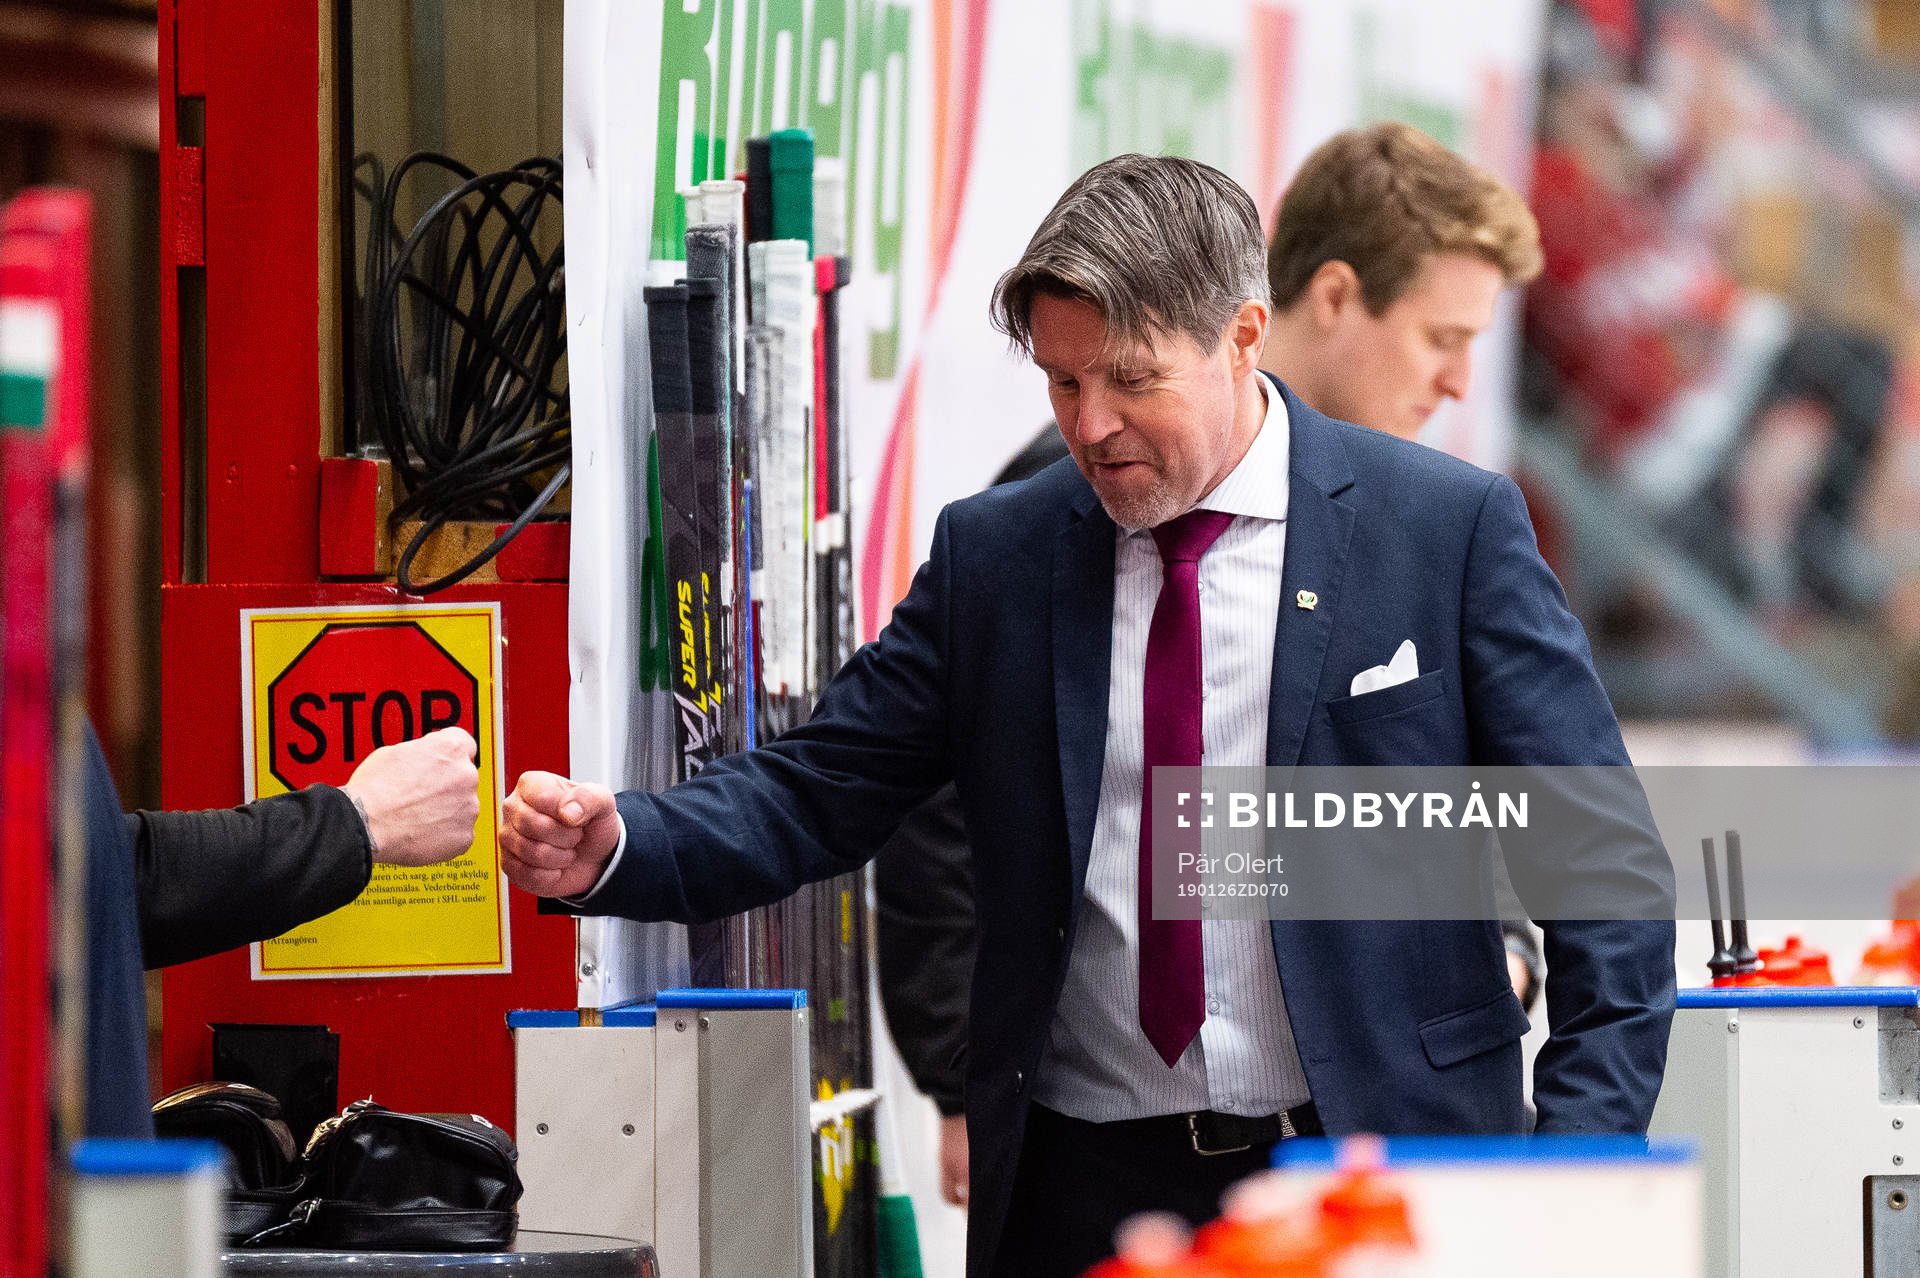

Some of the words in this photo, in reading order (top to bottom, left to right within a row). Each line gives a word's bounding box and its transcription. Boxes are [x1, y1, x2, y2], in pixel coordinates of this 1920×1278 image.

[677, 579, 698, 690] SUPER
[286, 689, 463, 765] STOP
[393, 872, 408, 881] och
[431, 872, 444, 882] gör
[447, 871, 458, 882] sig
[460, 869, 489, 881] skyldig
[366, 883, 420, 896] polisanmälas.
[423, 881, 481, 892] Vederbörande
[373, 896, 407, 908] samtliga
[408, 896, 434, 905] arenor
[442, 894, 459, 904] SHL
[462, 893, 487, 904] under
